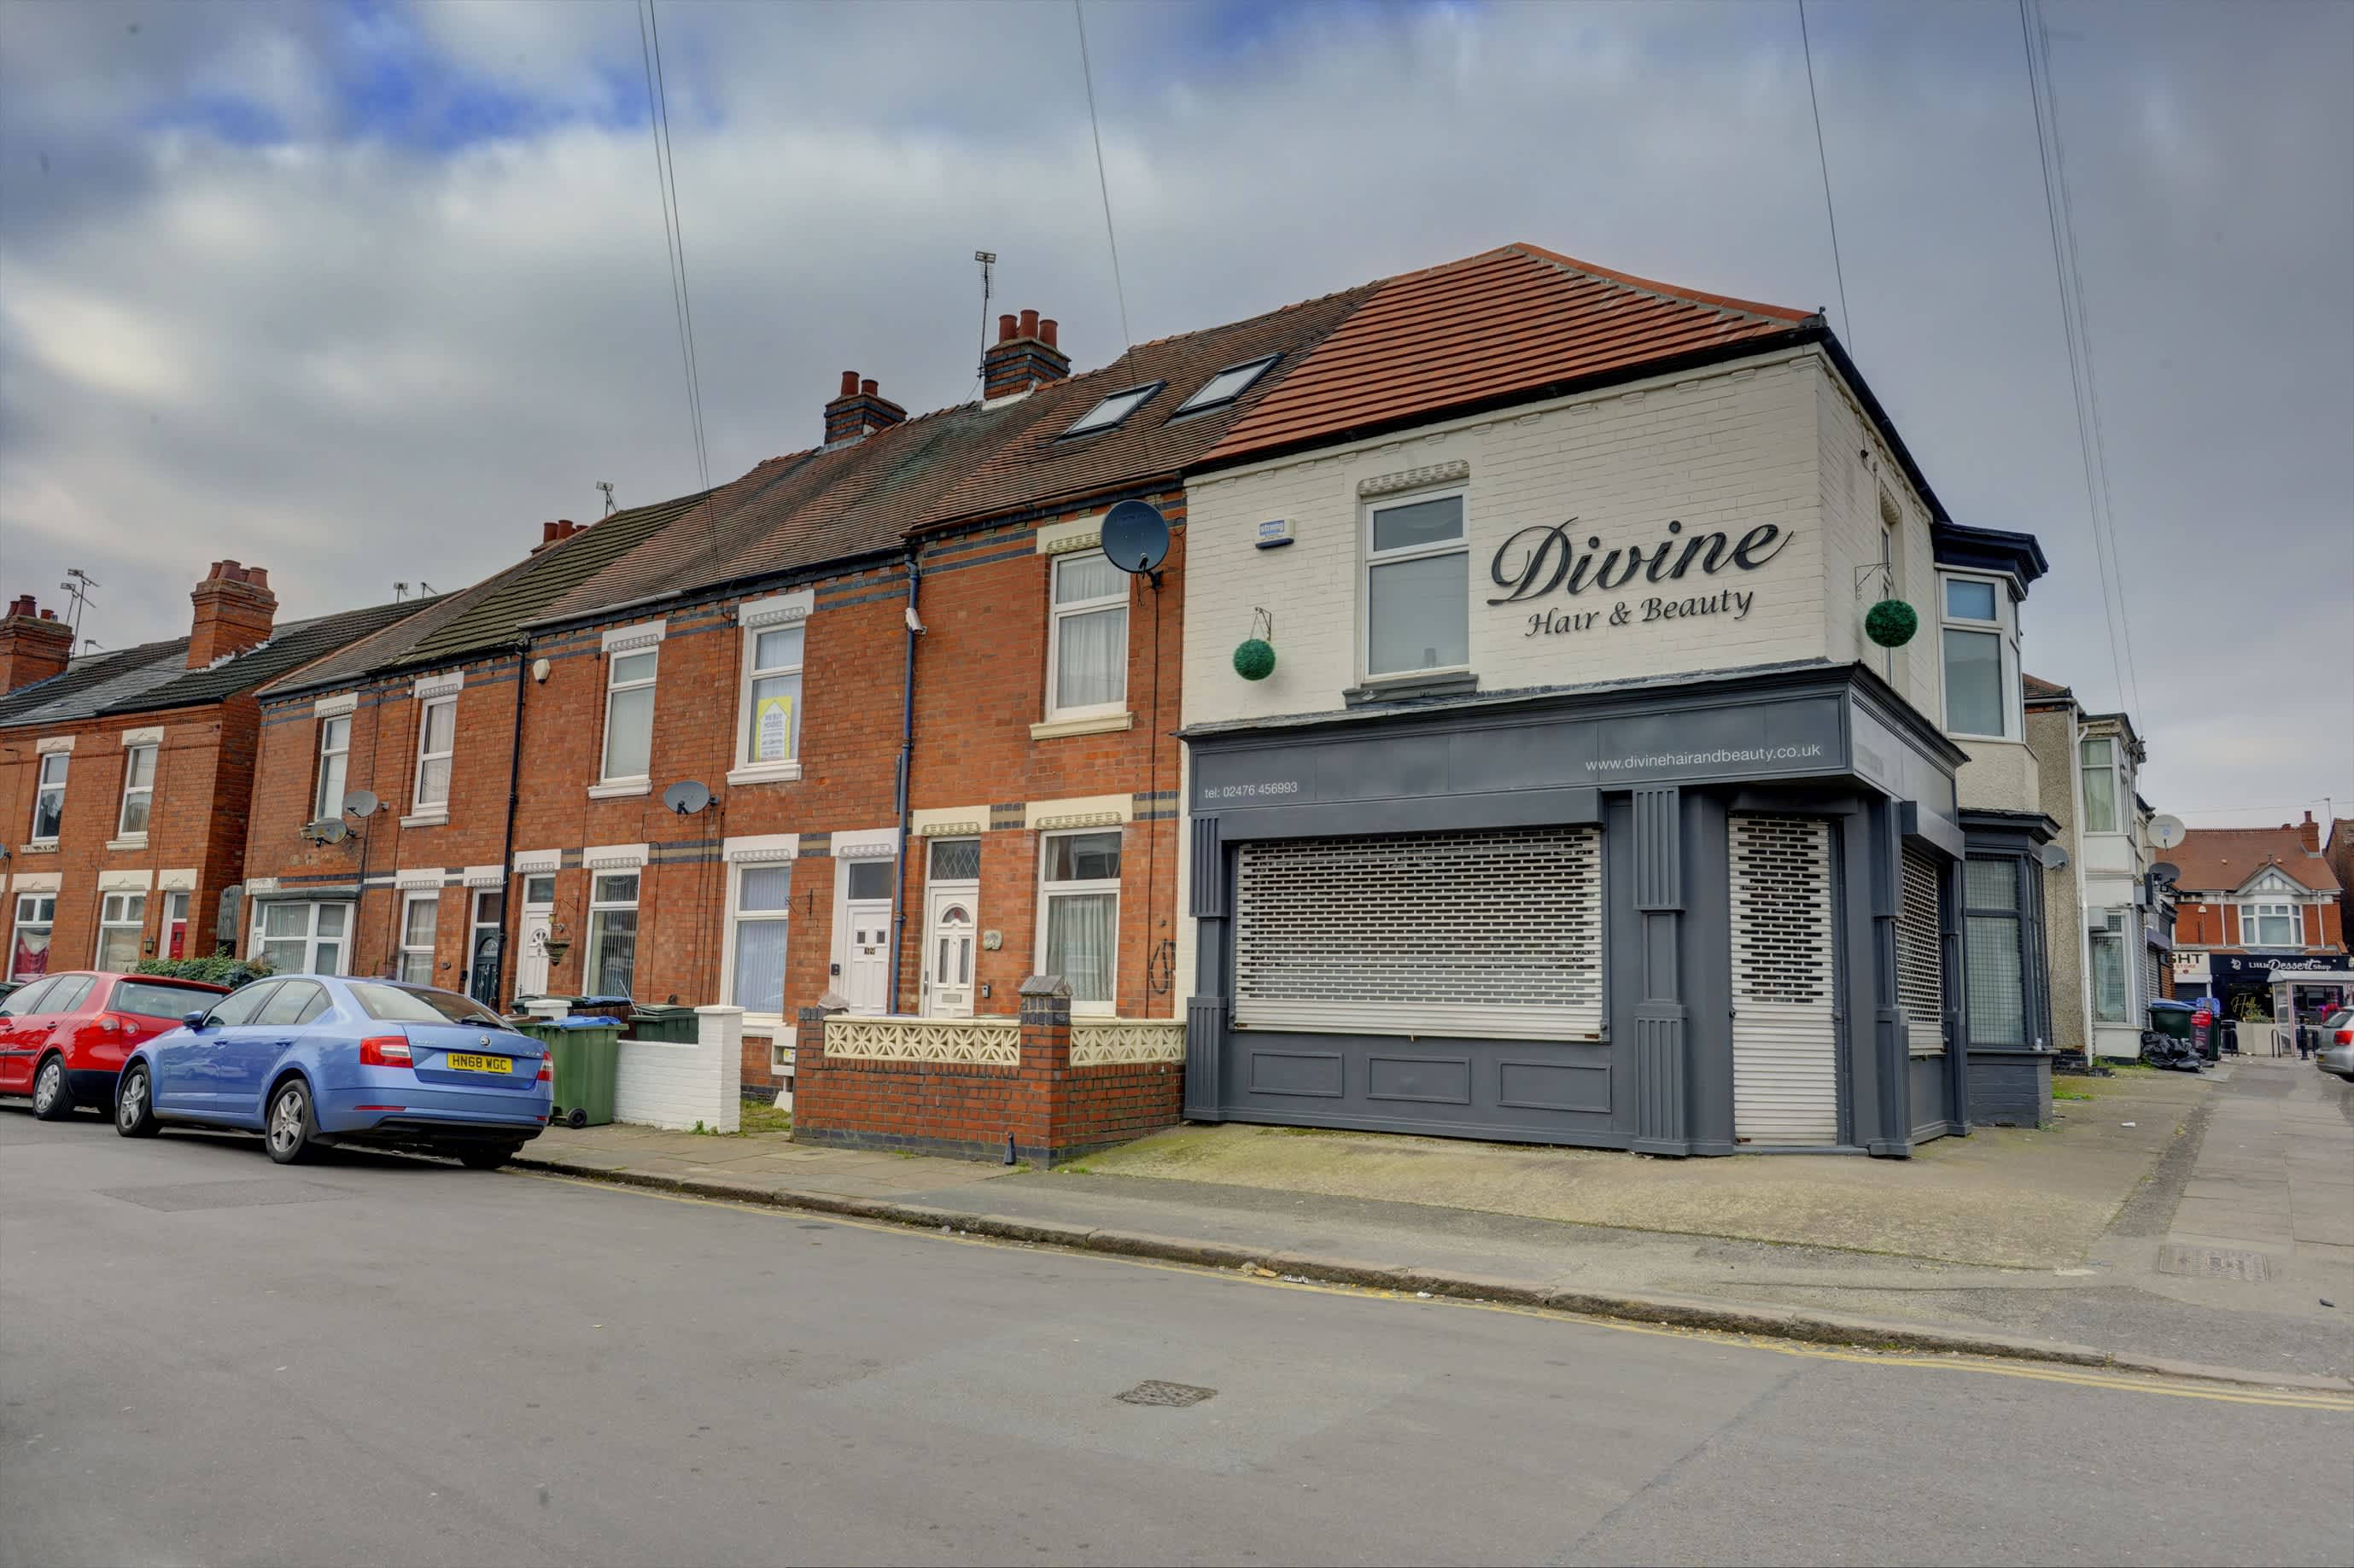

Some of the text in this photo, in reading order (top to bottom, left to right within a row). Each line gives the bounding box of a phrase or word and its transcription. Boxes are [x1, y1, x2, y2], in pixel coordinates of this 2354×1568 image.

[1487, 516, 1794, 606] Divine
[1524, 589, 1754, 638] Hair & Beauty
[1586, 743, 1821, 772] www.divinehairandbeauty.co.uk
[1205, 781, 1298, 799] tel: 02476 456993
[2268, 959, 2322, 971] Dessert
[453, 1055, 506, 1070] HN68 WGC
